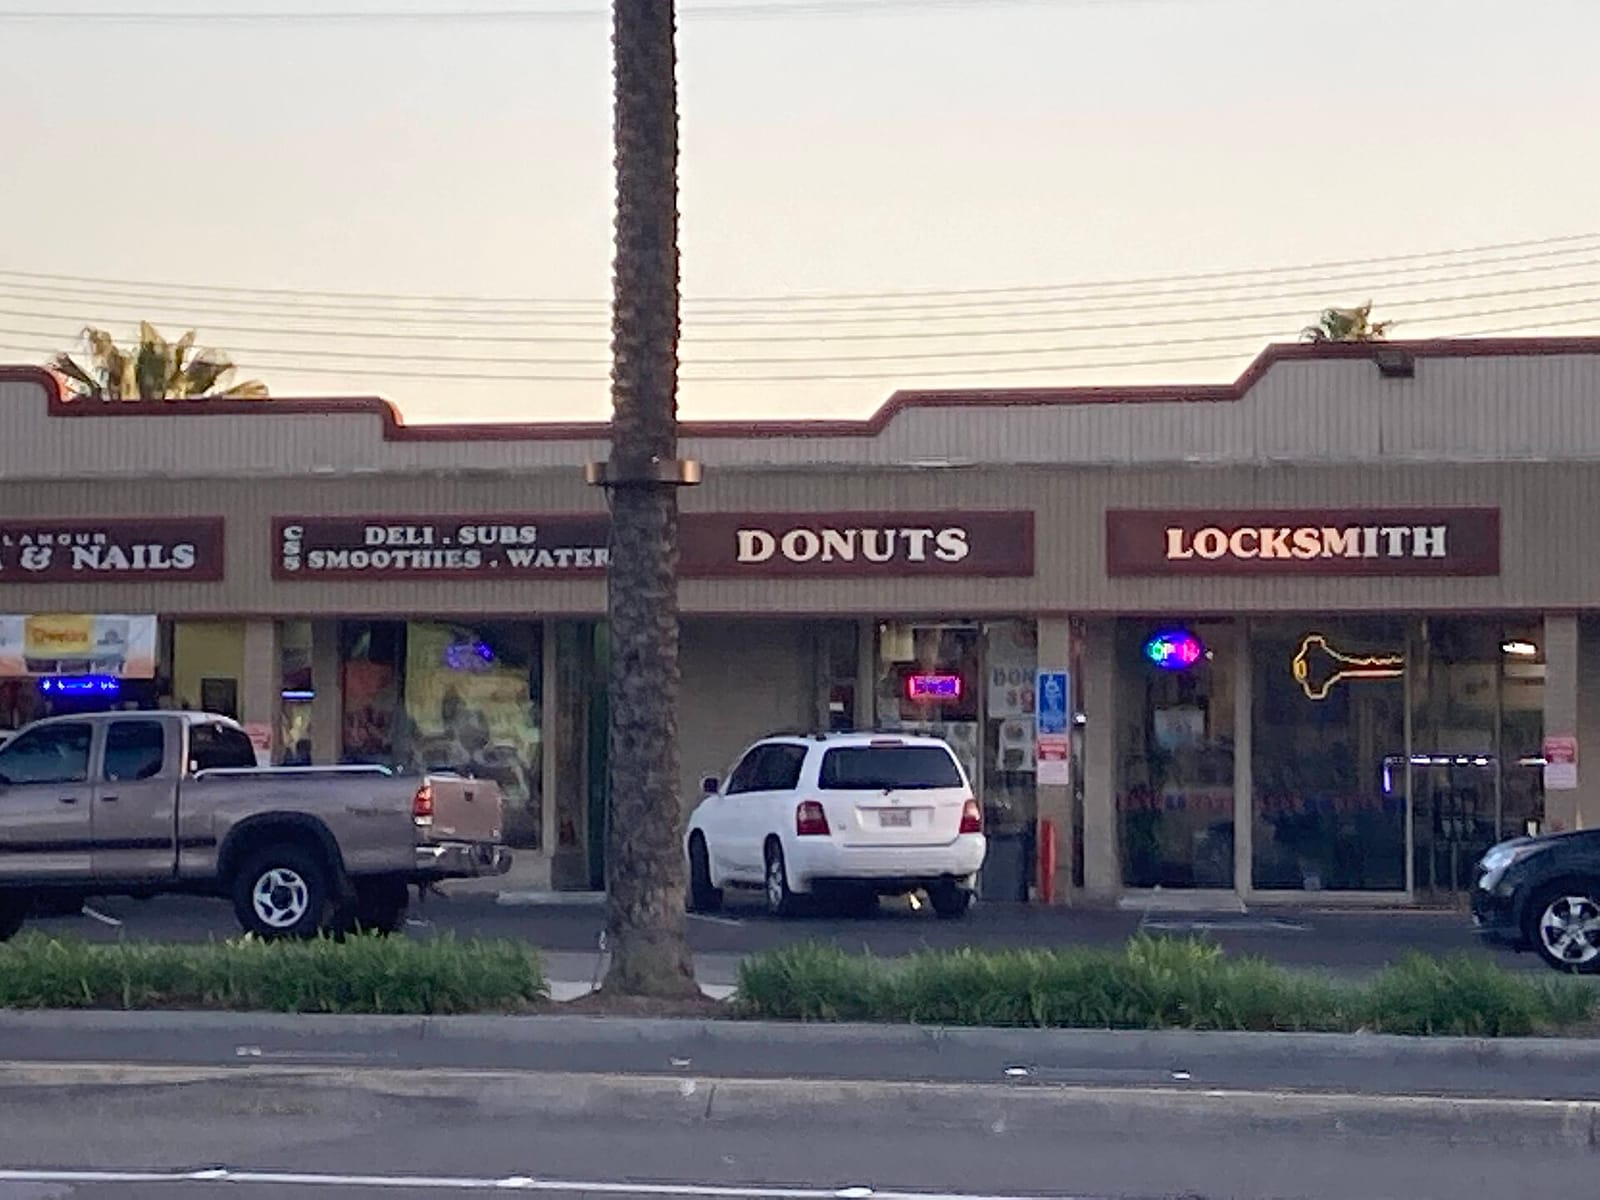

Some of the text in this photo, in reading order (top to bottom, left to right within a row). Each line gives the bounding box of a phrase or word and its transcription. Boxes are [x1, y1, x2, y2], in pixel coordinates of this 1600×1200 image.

[365, 526, 433, 545] DELI
[458, 526, 537, 545] SUBS
[736, 528, 969, 563] DONUTS
[1166, 526, 1446, 560] LOCKSMITH
[20, 544, 195, 571] & NAILS
[308, 549, 481, 569] SMOOTHIES
[506, 548, 612, 568] WATER
